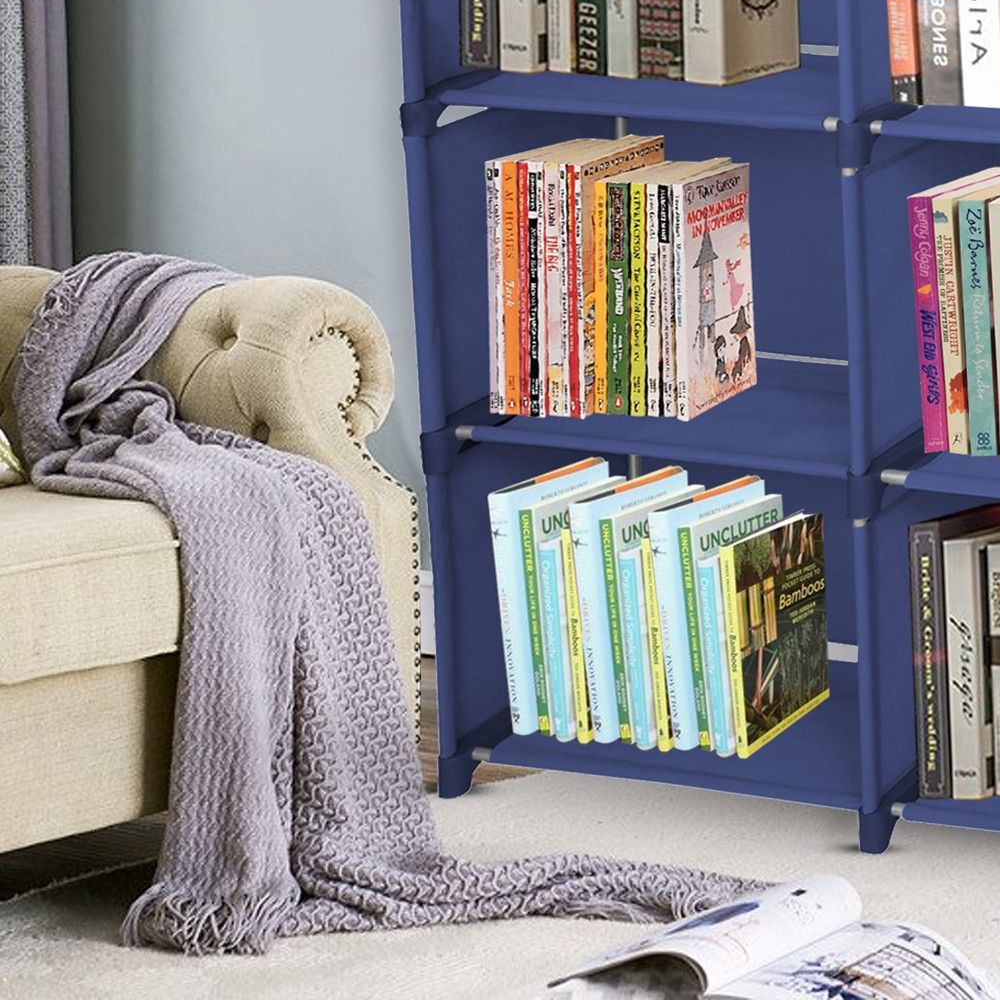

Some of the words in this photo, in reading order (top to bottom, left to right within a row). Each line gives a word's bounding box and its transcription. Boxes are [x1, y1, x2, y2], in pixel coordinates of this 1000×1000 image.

[579, 2, 597, 71] GEEZER
[633, 218, 642, 259] JACKSON
[692, 225, 702, 238] IN
[913, 207, 930, 239] Jenny
[967, 208, 985, 234] Zoë
[914, 242, 932, 278] Colgan
[942, 235, 953, 279] JUSTIN
[968, 238, 984, 290] Barnes
[919, 309, 936, 342] WEST
[946, 280, 959, 356] CARTWRIGHT
[522, 514, 533, 571] UNCLUTTER
[700, 507, 779, 552] UNCLUTTER
[602, 523, 614, 580] UNCLUTTER
[681, 531, 692, 589] UNCLUTTER
[779, 578, 825, 610] Bamboos
[570, 617, 580, 657] Bamboos
[650, 626, 660, 665] Bamboos
[729, 634, 738, 673] Bamboos
